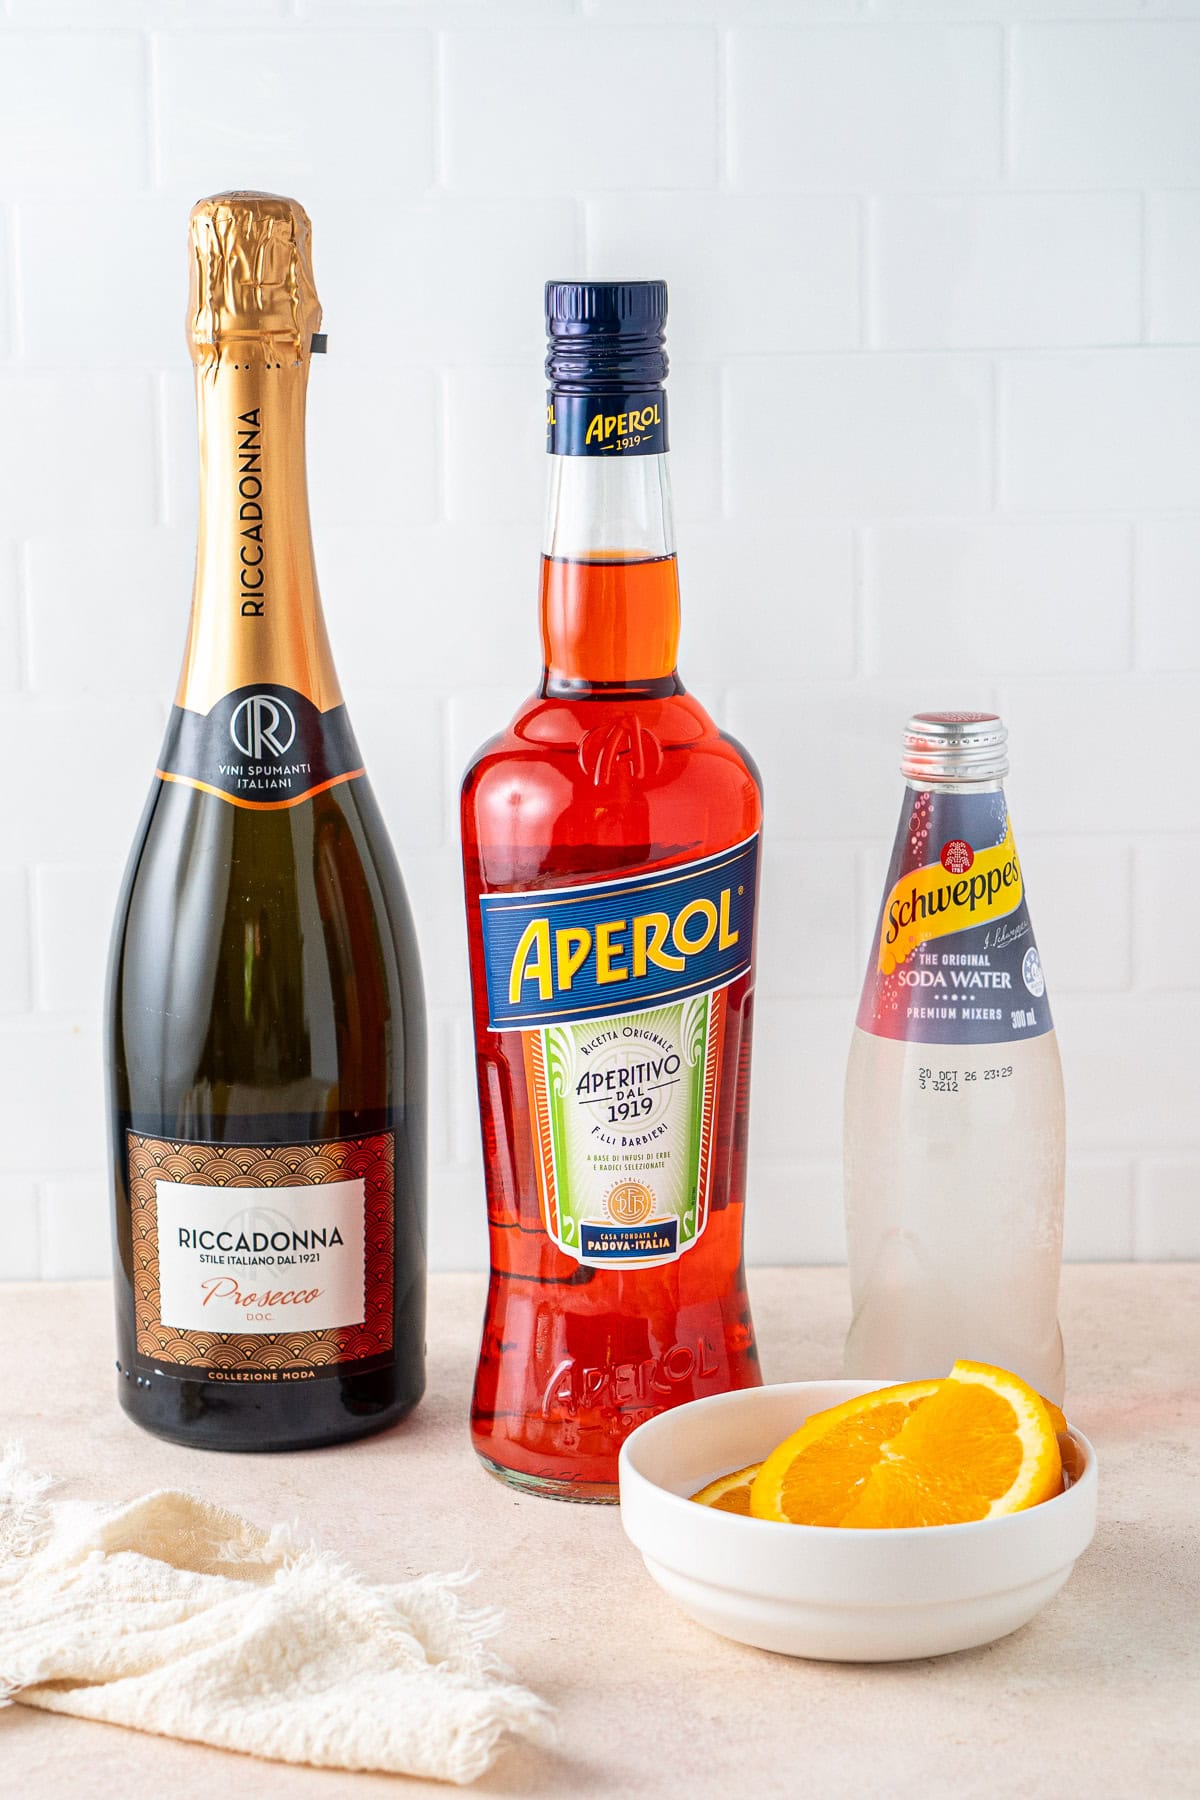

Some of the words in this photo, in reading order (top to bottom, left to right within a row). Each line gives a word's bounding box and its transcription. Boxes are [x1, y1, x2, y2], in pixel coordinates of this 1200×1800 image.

[585, 403, 661, 445] APEROL
[615, 436, 641, 451] 1919
[237, 408, 265, 617] RICCADONNA
[218, 764, 244, 776] VINI
[248, 763, 311, 776] SPUMANTI
[237, 778, 292, 789] ITALIANI
[886, 856, 1020, 944] Schweppes
[508, 888, 740, 1005] APEROL
[919, 954, 939, 966] THE
[941, 954, 991, 967] ORIGINAL
[897, 970, 948, 988] SODA
[950, 970, 1012, 989] WATER
[906, 1007, 957, 1020] PREMIUM
[961, 1007, 1003, 1020] MIXERS
[1010, 1009, 1027, 1029] 300
[580, 1030, 619, 1056] RICETTA
[575, 1054, 681, 1096] APERITIVO
[918, 1067, 932, 1079] 20
[939, 1071, 958, 1081] OCT
[965, 1071, 977, 1081] 26
[984, 1066, 1013, 1080] 23:29
[918, 1078, 927, 1090] 3
[932, 1081, 959, 1092] 3212
[616, 1087, 645, 1102] DAL
[607, 1097, 653, 1123] 1919
[593, 1154, 609, 1162] BASE
[612, 1154, 619, 1162] DI
[622, 1153, 644, 1161] INFUSI
[656, 1151, 671, 1159] ERBE
[624, 1161, 665, 1171] SELEZIONATE
[178, 1227, 344, 1253] RICCADONNA
[620, 1232, 651, 1240] FONDATA
[199, 1254, 225, 1265] STILE
[227, 1255, 275, 1266] ITALIANO
[277, 1255, 297, 1265] DAL
[298, 1253, 320, 1264] 1921
[201, 1276, 326, 1308] Prosecco
[208, 1371, 278, 1381] COLLEZIONE
[282, 1370, 316, 1380] MODA
[541, 1337, 719, 1418] APEROL
